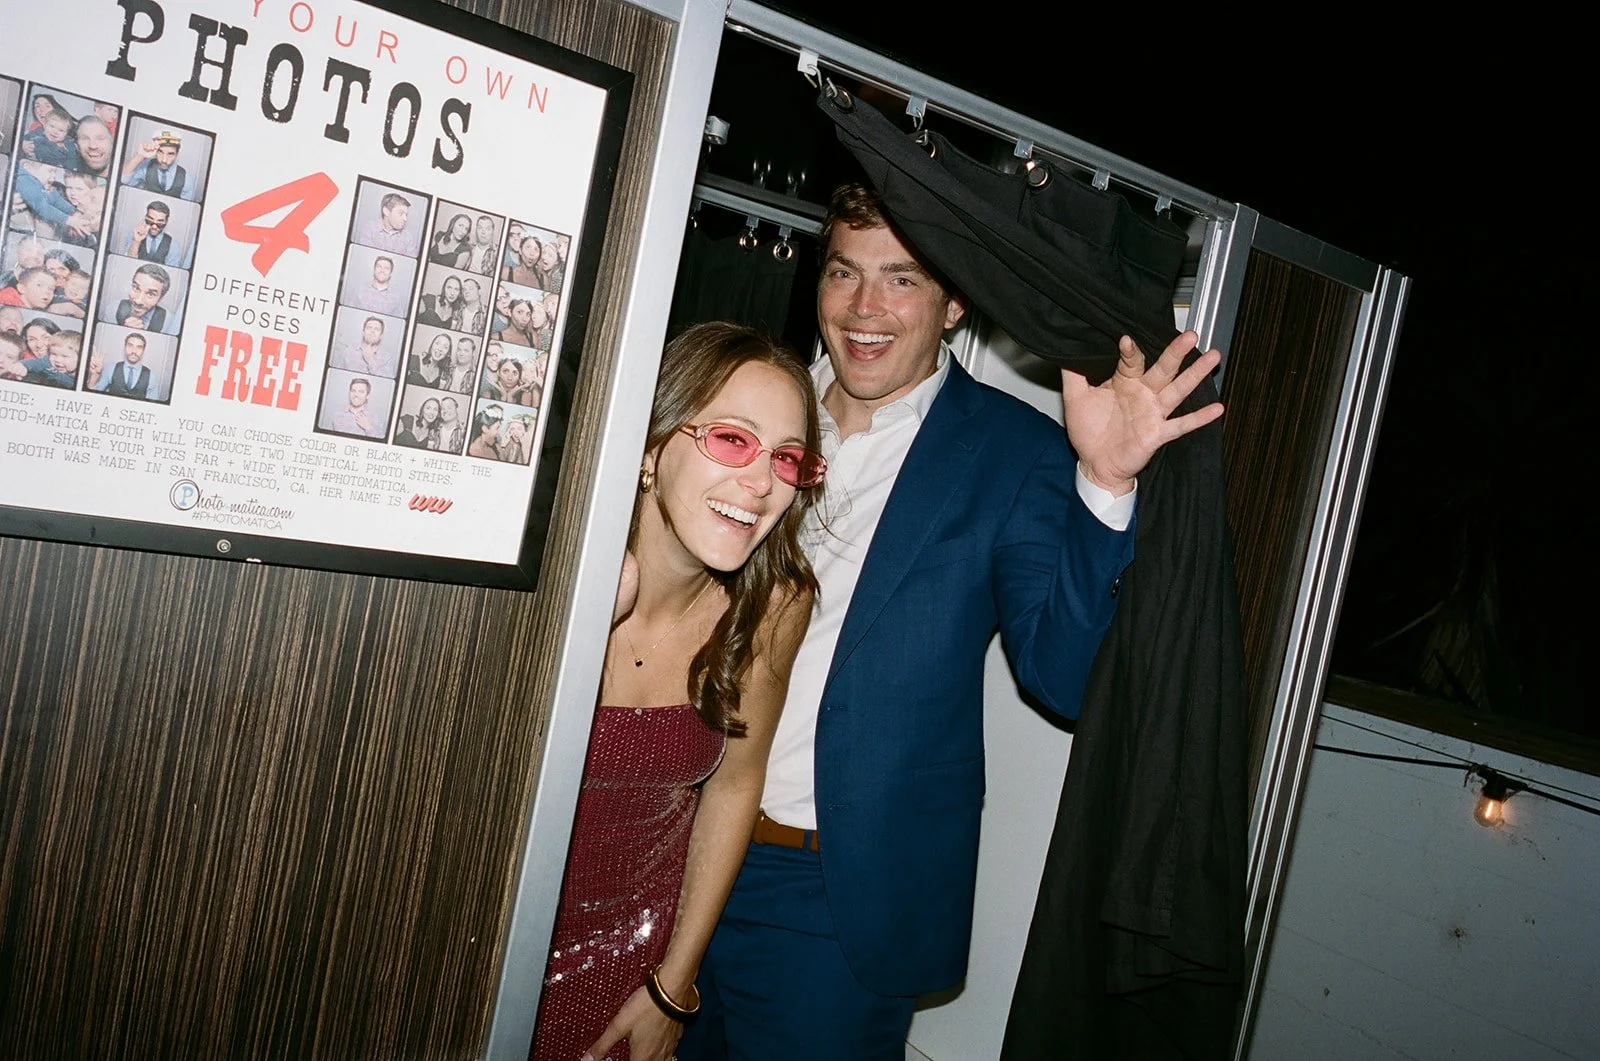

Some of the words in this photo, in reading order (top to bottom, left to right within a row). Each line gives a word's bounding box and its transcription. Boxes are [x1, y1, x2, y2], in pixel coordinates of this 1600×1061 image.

[105, 0, 472, 175] PHOTOS
[253, 0, 400, 63] YOUR
[445, 55, 549, 114] OWN
[220, 171, 339, 278] 4
[204, 273, 330, 315] DIFFERENT
[226, 304, 300, 335] POSES
[195, 324, 308, 411] FREE
[0, 390, 34, 406] IDE:
[56, 399, 92, 415] HAVE
[101, 407, 110, 418] A
[119, 409, 157, 425] SEAT.
[179, 418, 204, 433] YOU
[211, 423, 237, 437] CAN
[244, 428, 293, 446] CHOOSE
[300, 438, 337, 453] COLOR
[344, 445, 359, 457] OR
[366, 449, 402, 464] BLACK
[423, 457, 462, 473] WHITE.
[471, 464, 492, 478] THE
[53, 431, 100, 450] SHARE
[110, 439, 145, 456] YOUR
[153, 446, 186, 461] PICS
[194, 452, 219, 466] FAR
[228, 459, 235, 467] +
[243, 459, 276, 474] WIDE
[282, 465, 315, 480] WITH
[321, 471, 410, 494] #PHOTOMATICA.
[98, 423, 144, 440] BOOTH
[152, 431, 186, 446] WILL
[195, 436, 252, 455] PRODUCE
[260, 446, 284, 460] TWO
[293, 451, 359, 472] IDENTICAL
[365, 463, 402, 478] PHOTO
[408, 470, 454, 486] STRIPS.
[7, 441, 54, 460] BOOTH
[64, 450, 91, 464] WAS
[98, 455, 137, 471] MADE
[144, 461, 162, 474] IN
[169, 464, 196, 478] SAN
[203, 469, 280, 492] FRANCISCO,
[290, 481, 310, 495] CA.
[319, 486, 343, 500] HER
[350, 491, 381, 506] NAME
[388, 496, 402, 507] IS
[192, 511, 283, 530] #PHOTOMATICA
